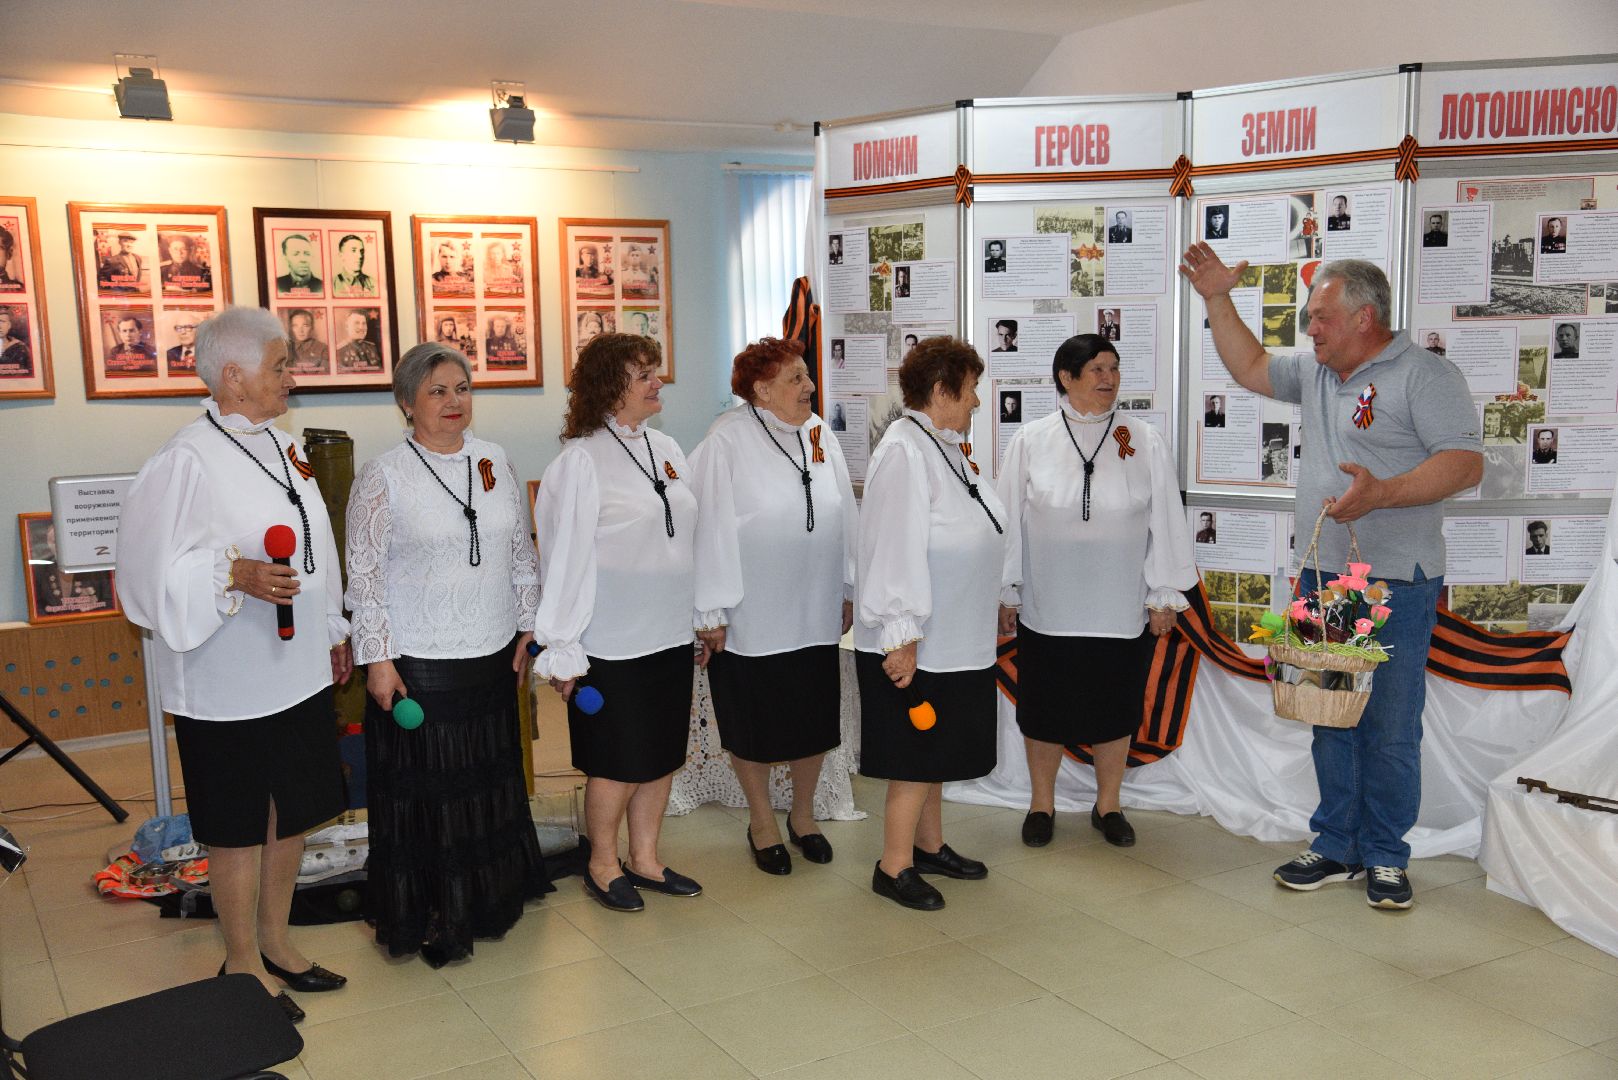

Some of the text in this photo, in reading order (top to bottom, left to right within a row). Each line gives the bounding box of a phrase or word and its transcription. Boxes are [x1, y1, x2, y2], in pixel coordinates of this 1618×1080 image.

[853, 85, 1618, 181] ПОМНИМ ГЕРОЕВ ЗЕМЛИ ЛОТОШИНСКО
[69, 529, 114, 537] территории
